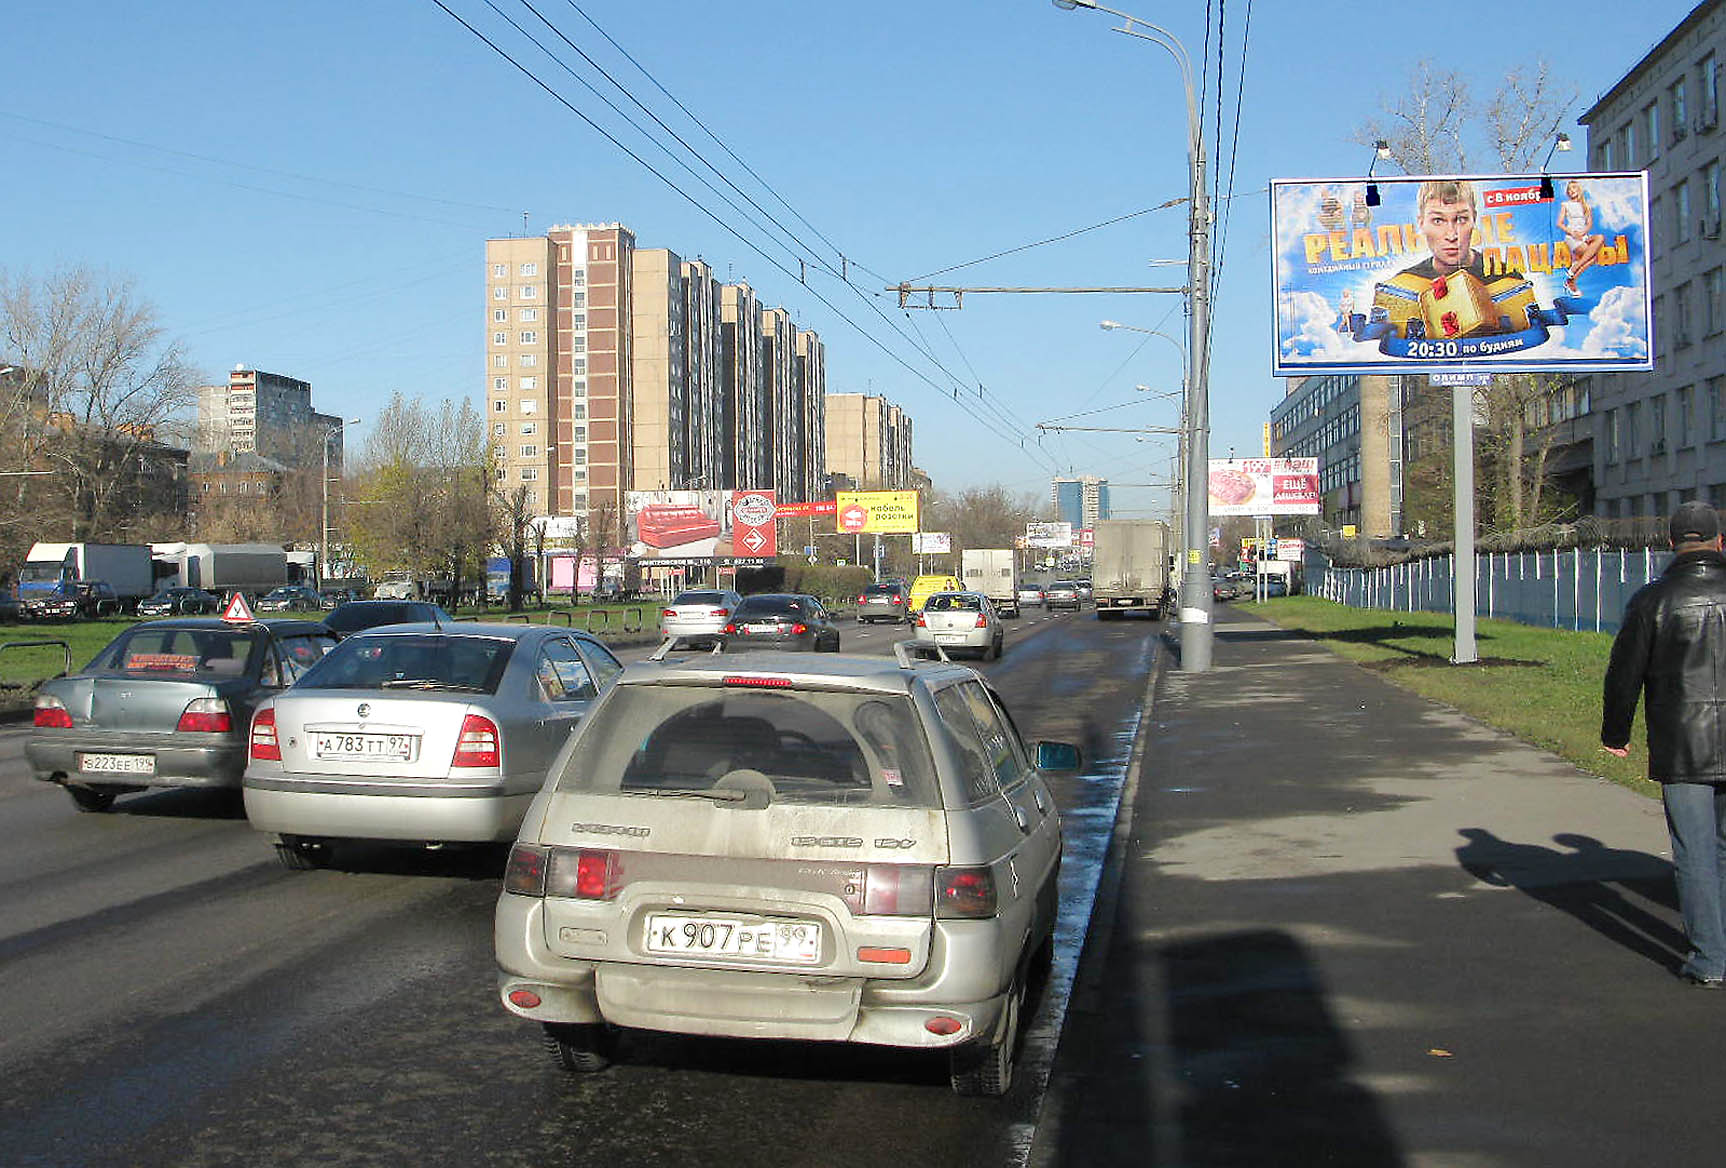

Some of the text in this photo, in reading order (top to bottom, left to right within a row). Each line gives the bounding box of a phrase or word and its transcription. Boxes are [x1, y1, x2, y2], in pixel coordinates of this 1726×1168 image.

[1505, 187, 1541, 202] ноябр
[1304, 212, 1516, 264] РЕАЛЬЫЕ
[1482, 234, 1630, 277] ПАЦАЫ
[1407, 338, 1524, 357] 20:30 по будням
[1432, 373, 1474, 382] ОЛИМП
